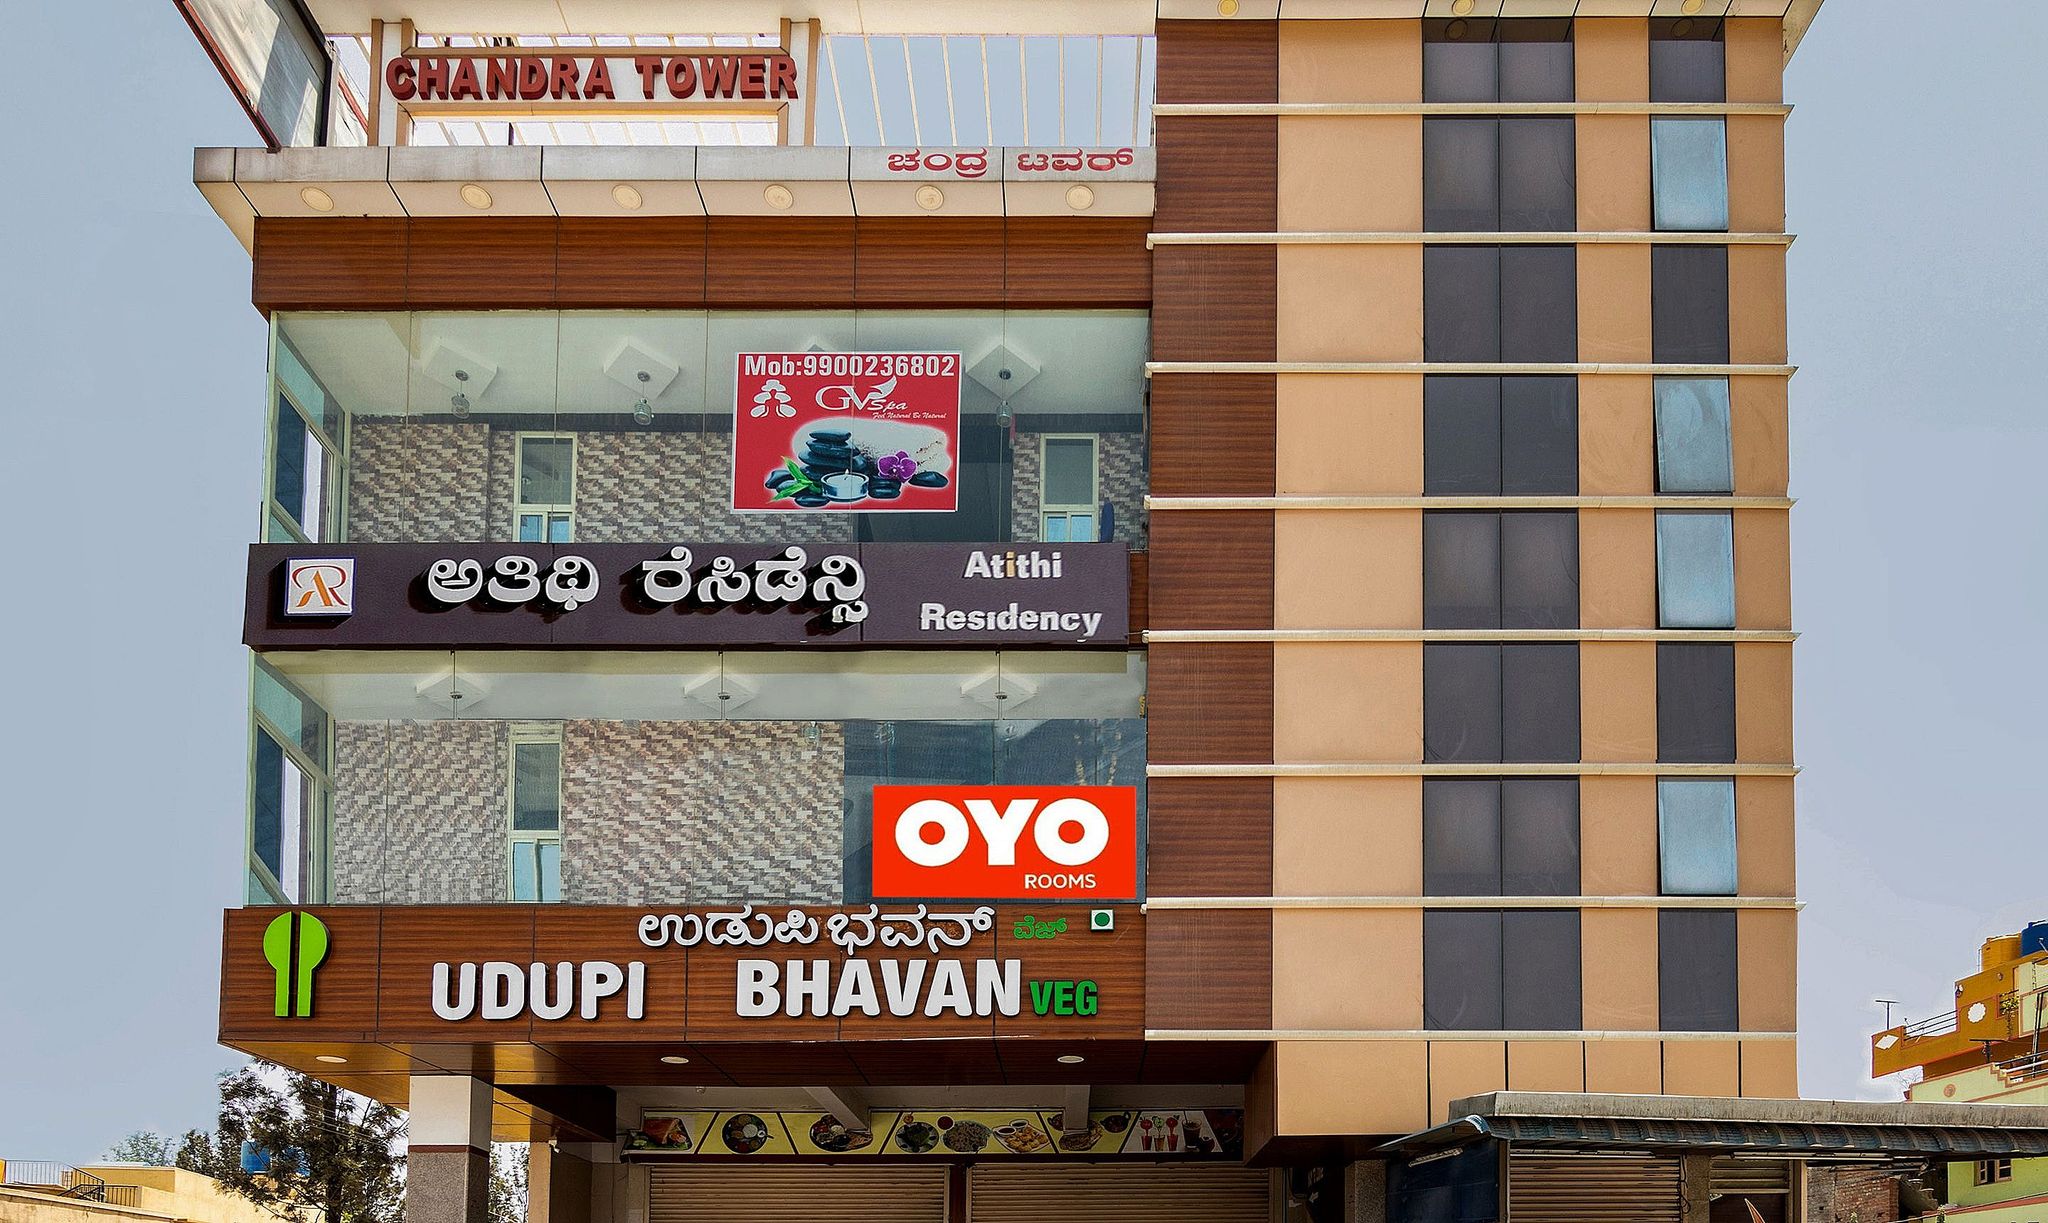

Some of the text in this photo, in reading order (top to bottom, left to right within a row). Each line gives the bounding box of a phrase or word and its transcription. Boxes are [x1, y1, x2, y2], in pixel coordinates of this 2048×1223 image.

[386, 55, 799, 100] CHANDRA TOWER
[887, 148, 1134, 178] ಚಂದ್ರ ಟವರ್
[867, 399, 908, 413] Spa
[887, 411, 912, 420] Natural
[912, 411, 921, 419] Be
[922, 411, 947, 419] Natural
[963, 551, 1063, 578] Atithi
[920, 602, 1102, 642] Residency
[895, 798, 1110, 867] OYO
[1024, 874, 1097, 889] ROOMS
[638, 903, 1068, 955] ಉಡುಪಿ ಭವನ್ ವೆಜ್
[431, 958, 1099, 1021] UDUPI BHAVAN VEG
